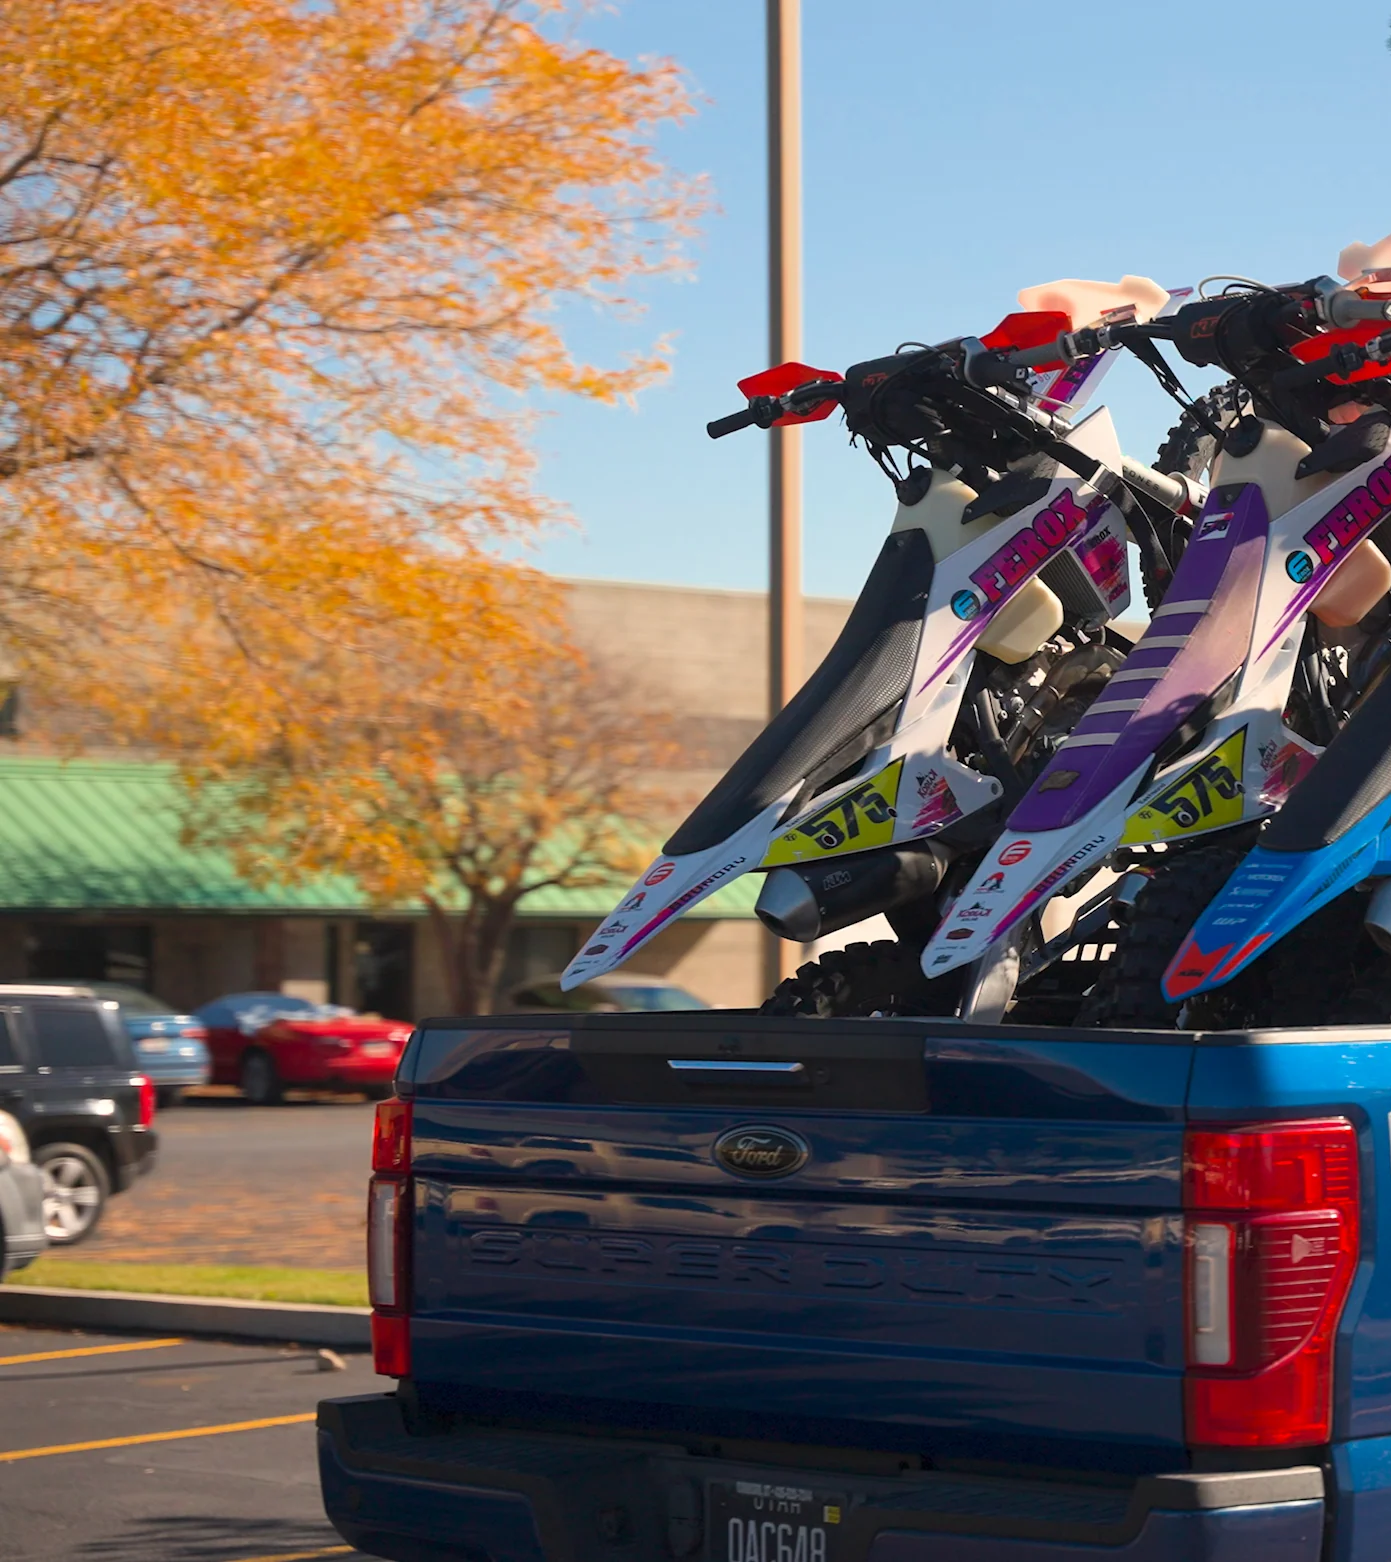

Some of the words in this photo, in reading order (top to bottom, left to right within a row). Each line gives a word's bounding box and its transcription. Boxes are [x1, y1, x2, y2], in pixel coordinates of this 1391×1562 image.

[969, 487, 1088, 603] FEROX
[796, 783, 892, 850] 575
[1149, 755, 1242, 828] 575
[730, 1136, 786, 1168] Ford
[469, 1228, 792, 1284] SUPER
[820, 1251, 1115, 1303] DUTY
